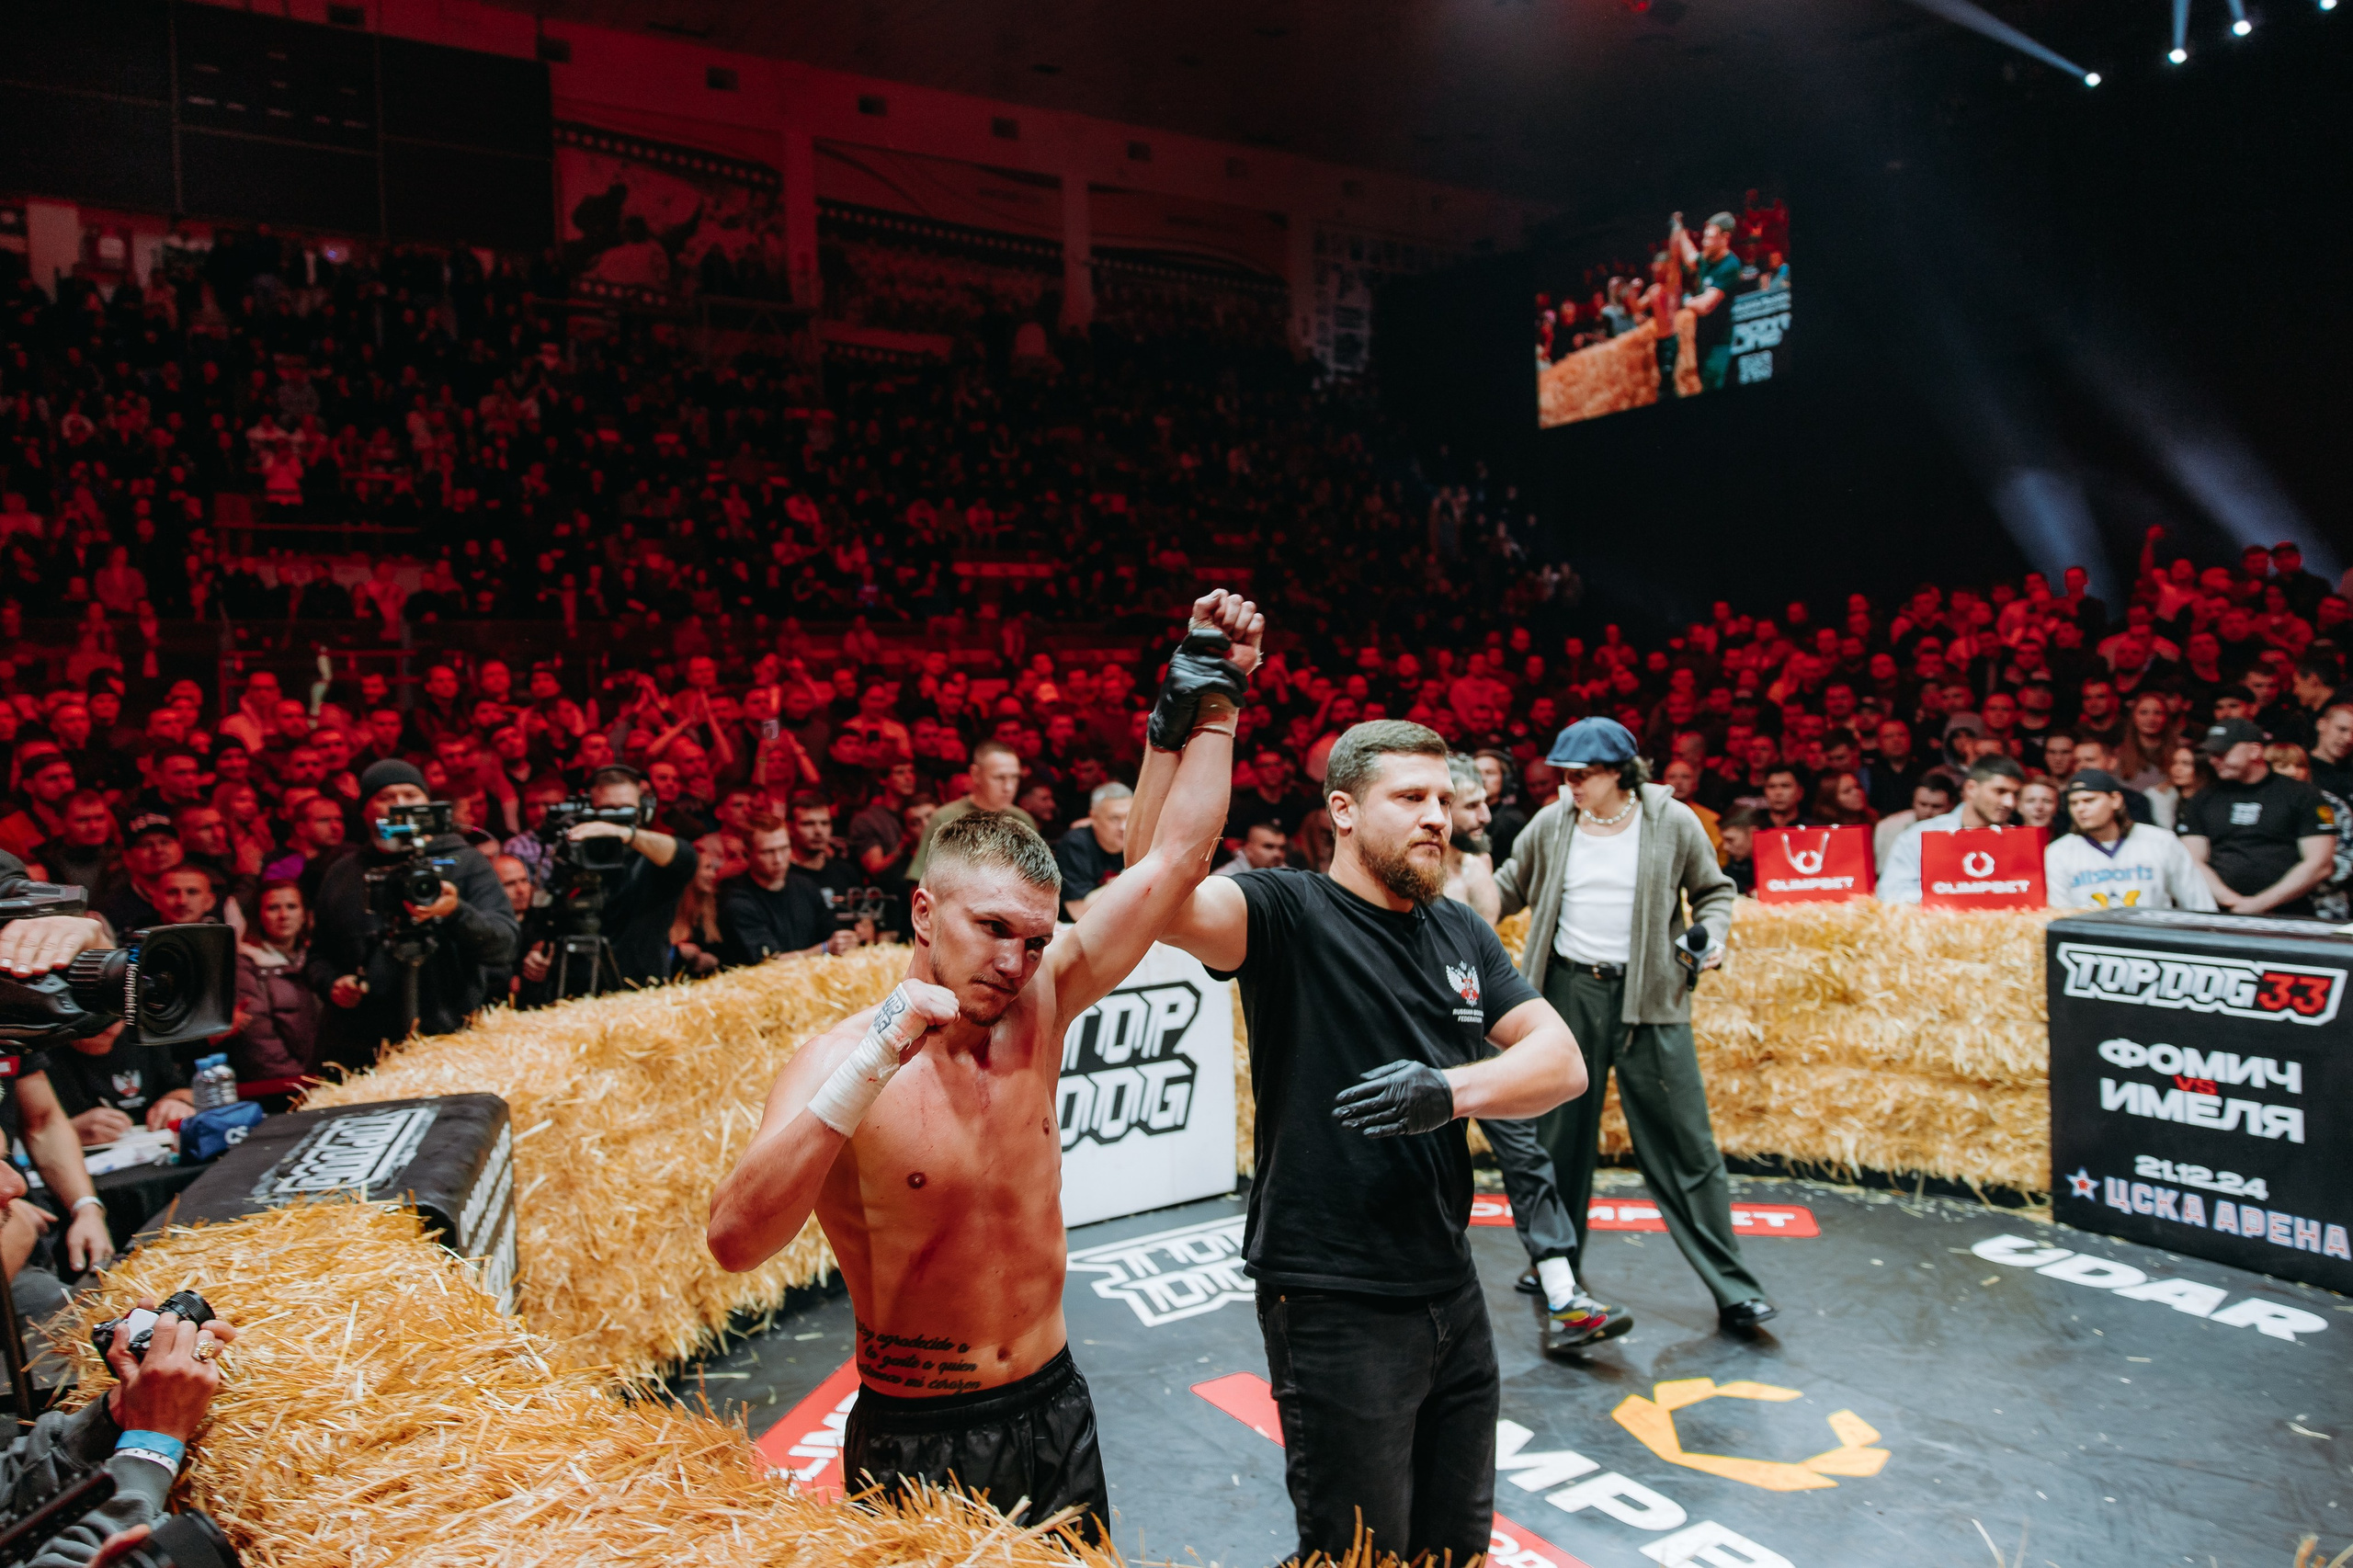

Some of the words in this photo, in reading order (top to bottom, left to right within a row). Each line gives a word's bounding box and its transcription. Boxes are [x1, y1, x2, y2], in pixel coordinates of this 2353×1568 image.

[2097, 1037, 2302, 1095] ФОМИЧ
[2099, 1077, 2305, 1144] ИМЕЛЯ
[2104, 1176, 2207, 1228] ЦСКА
[2213, 1199, 2351, 1261] АРЕНА
[1971, 1233, 2329, 1342] UDAR
